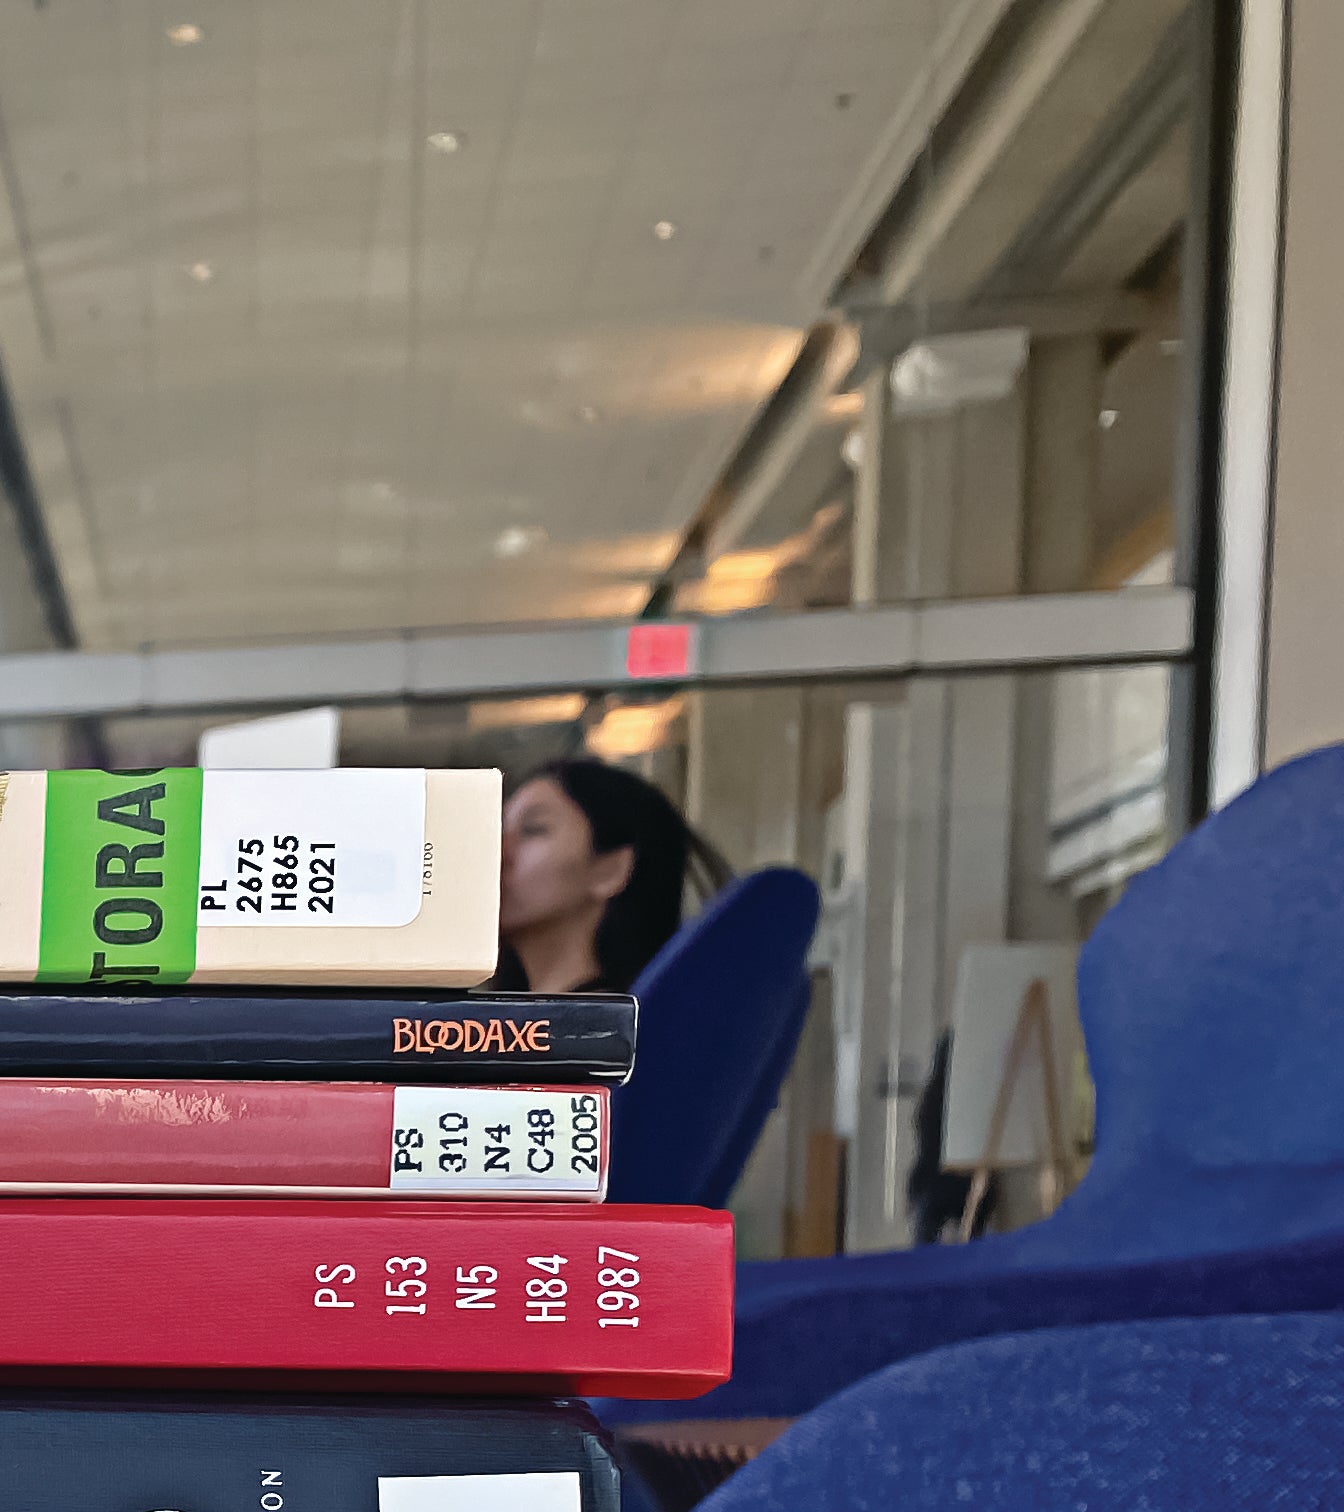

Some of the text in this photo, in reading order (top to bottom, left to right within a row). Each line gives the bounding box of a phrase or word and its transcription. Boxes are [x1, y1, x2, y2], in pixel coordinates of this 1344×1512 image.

[88, 767, 168, 986] TORA
[200, 879, 228, 911] PL
[235, 838, 265, 914] 2675
[270, 835, 300, 911] H865
[307, 843, 336, 914] 2021
[392, 1018, 551, 1055] BLOODAXE
[393, 1128, 424, 1173] PS
[438, 1112, 469, 1173] 310
[483, 1123, 511, 1173] N4
[526, 1108, 555, 1174] C48
[570, 1094, 598, 1174] 2005
[314, 1264, 356, 1308] PS
[385, 1256, 428, 1316] 153
[455, 1265, 498, 1309] N5
[525, 1254, 569, 1322] H84
[596, 1246, 640, 1329] 1987
